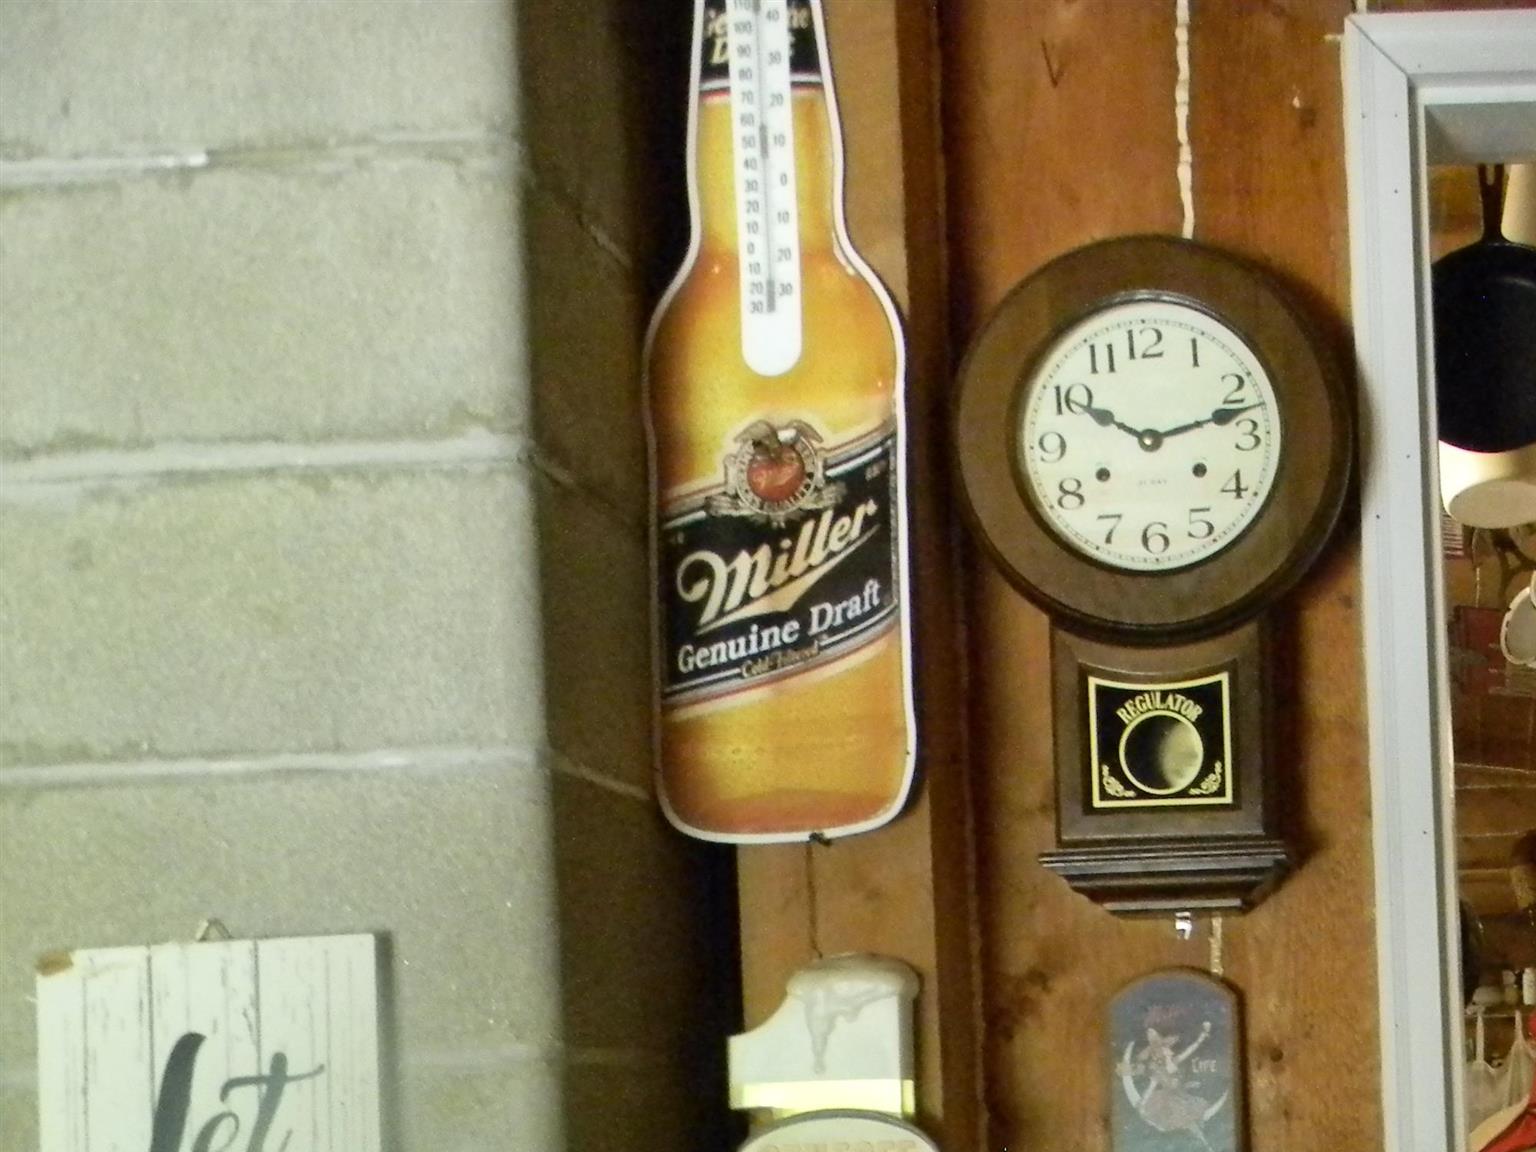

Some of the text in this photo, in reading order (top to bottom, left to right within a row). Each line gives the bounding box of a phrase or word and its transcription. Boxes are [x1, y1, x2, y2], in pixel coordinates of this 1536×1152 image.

[746, 200, 760, 213] 20
[747, 221, 759, 234] 10
[777, 248, 792, 261] 20
[750, 282, 764, 295] 20
[779, 283, 793, 296] 30
[1089, 343, 1117, 374] 11
[1127, 327, 1164, 360] 12
[1190, 338, 1200, 368] 1
[1054, 383, 1094, 416] 10
[1220, 373, 1246, 405] 2
[1038, 431, 1067, 463] 9
[1234, 418, 1261, 451] 3
[1057, 477, 1085, 510] 8
[1220, 469, 1249, 500] 4
[1096, 513, 1123, 545] 7
[1141, 522, 1170, 554] 6
[1187, 507, 1215, 540] 5
[677, 499, 879, 625] Miller
[677, 618, 801, 674] Genuine
[807, 578, 881, 637] Draft
[1116, 690, 1204, 725] REGULATOR
